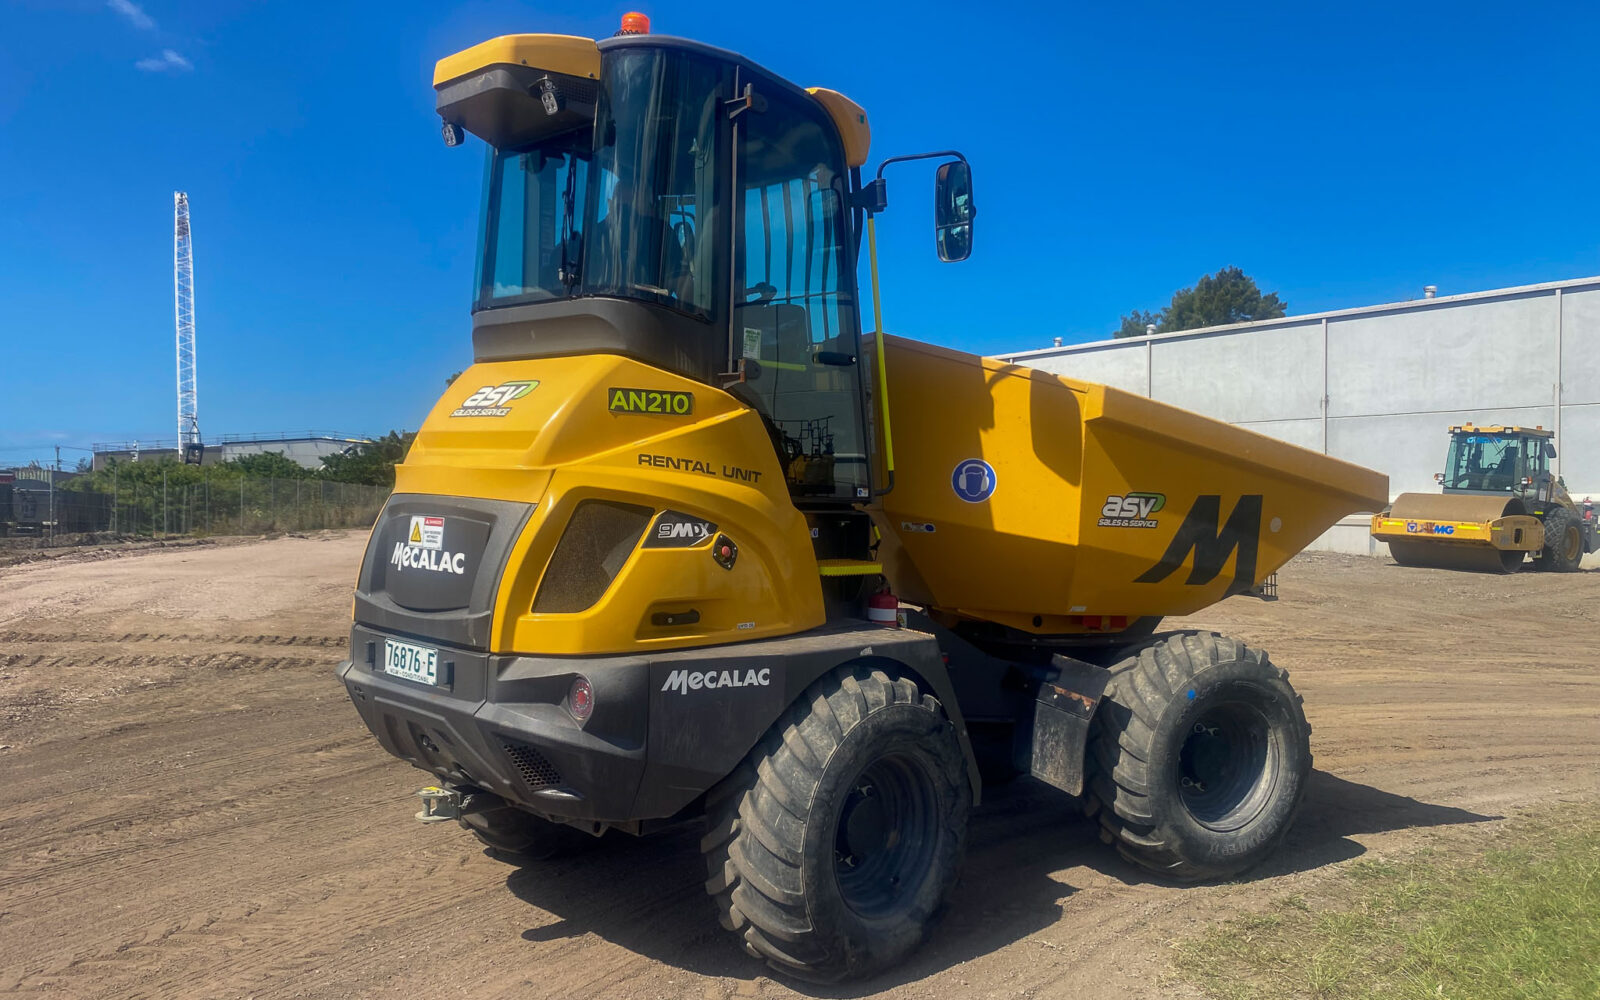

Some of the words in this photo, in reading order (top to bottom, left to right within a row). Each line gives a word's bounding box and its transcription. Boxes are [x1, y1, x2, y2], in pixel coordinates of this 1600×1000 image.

[610, 391, 689, 414] AN210
[638, 454, 716, 475] RENTAL
[723, 466, 761, 483] UNIT
[1129, 519, 1158, 528] SERVICE
